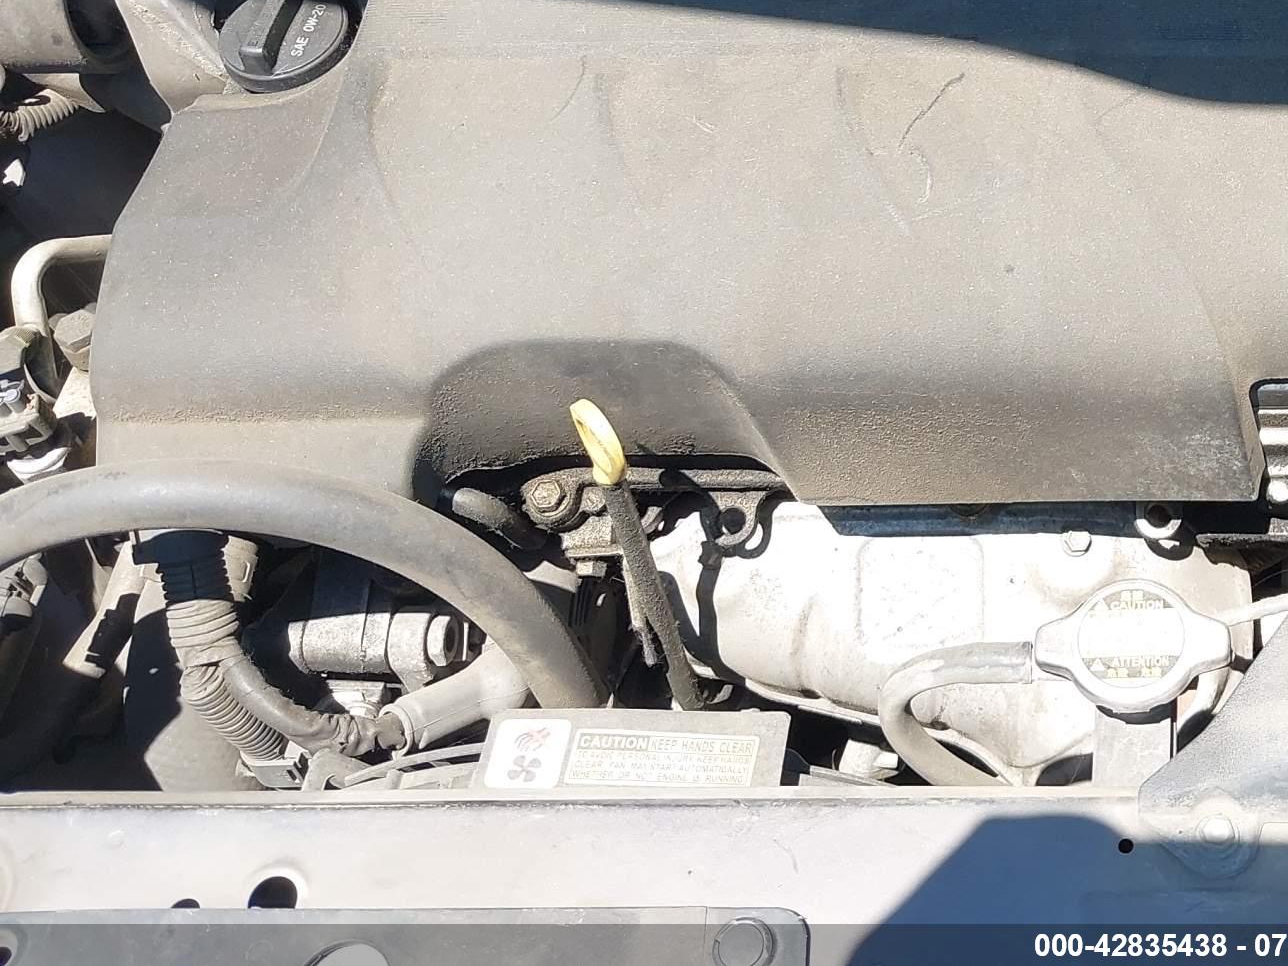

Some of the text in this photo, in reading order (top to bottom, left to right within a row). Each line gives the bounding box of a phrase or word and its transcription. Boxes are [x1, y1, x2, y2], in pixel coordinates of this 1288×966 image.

[290, 3, 327, 57] SAE 0W-20
[1110, 600, 1164, 610] CAUTION
[1112, 656, 1169, 668] ATTENTION
[580, 735, 752, 754] CAUTION KEEP HANDS CLEAR
